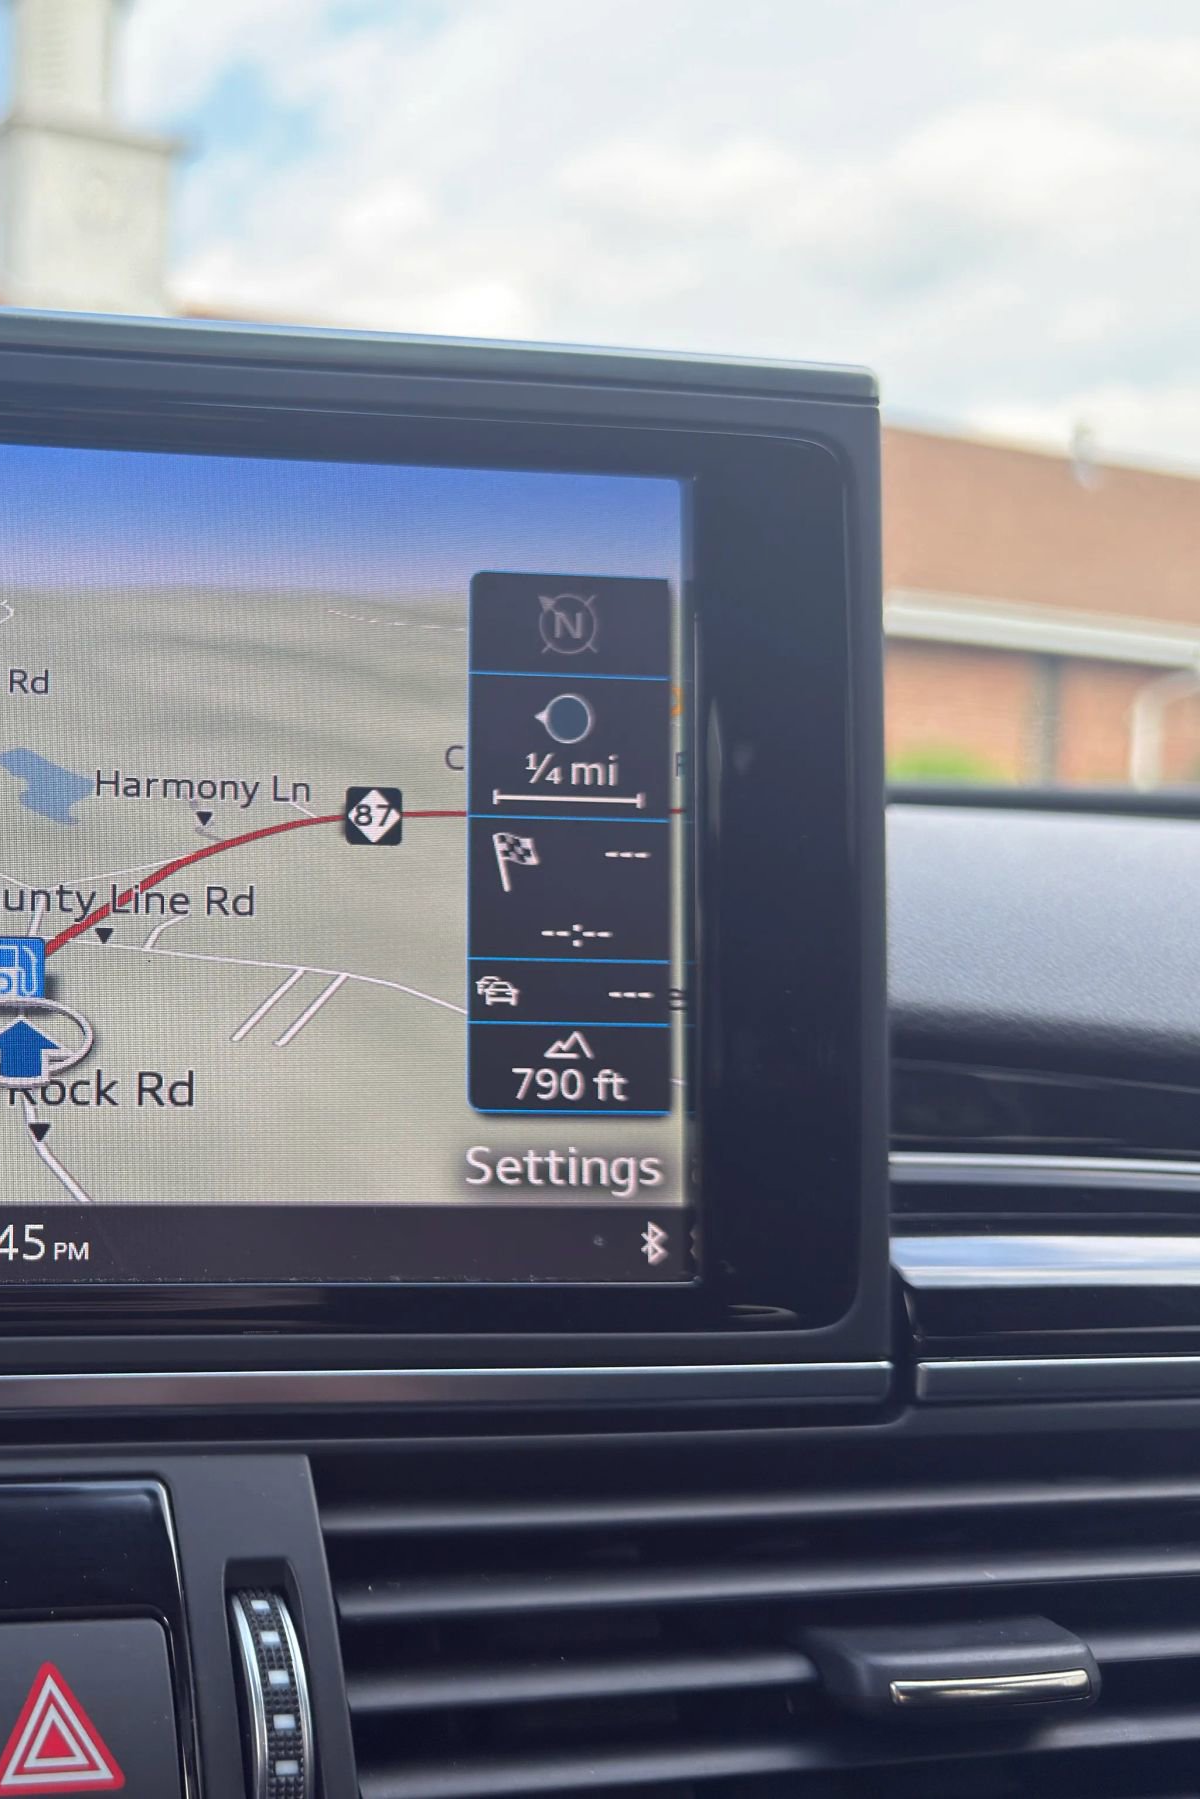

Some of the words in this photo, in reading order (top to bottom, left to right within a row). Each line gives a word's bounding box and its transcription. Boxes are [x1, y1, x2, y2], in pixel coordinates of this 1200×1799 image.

[9, 669, 50, 695] Rd
[570, 753, 620, 787] mi
[96, 769, 260, 808] Harmony
[273, 775, 311, 803] Ln
[354, 803, 392, 827] 87
[111, 884, 191, 917] Line
[206, 885, 256, 917] Rd
[137, 1069, 195, 1107] Rd
[511, 1067, 586, 1101] 790
[592, 1068, 630, 1102] ft
[465, 1145, 665, 1198] Settings
[53, 1241, 90, 1261] PM
